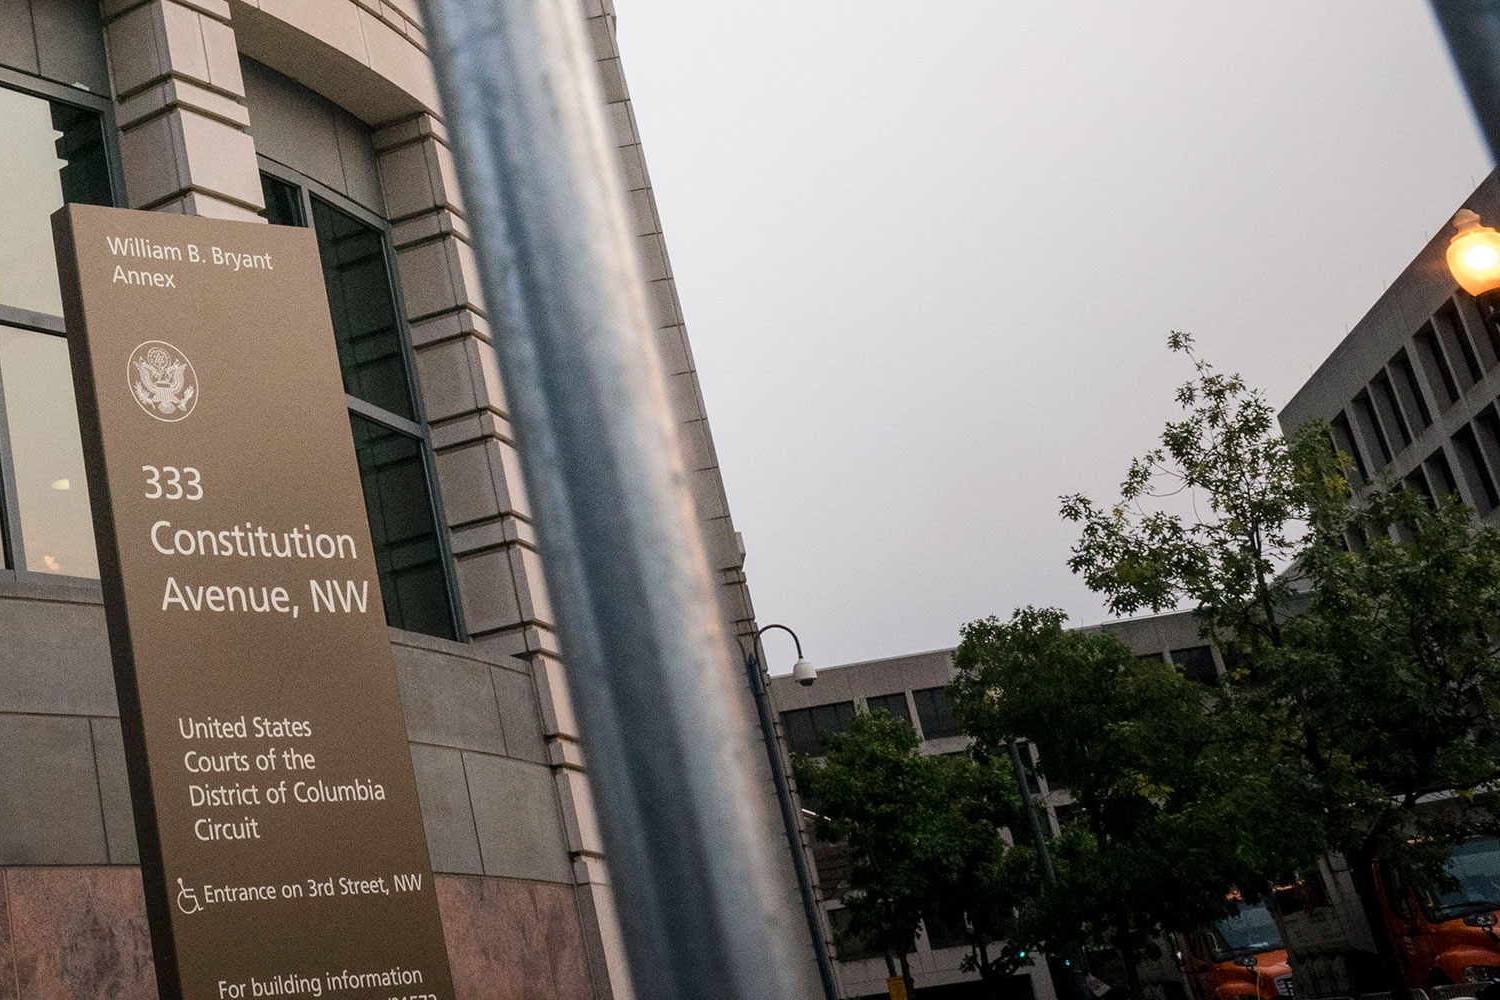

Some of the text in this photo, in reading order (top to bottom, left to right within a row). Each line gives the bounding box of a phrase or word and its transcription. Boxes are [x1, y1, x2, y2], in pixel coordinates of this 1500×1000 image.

[107, 236, 274, 271] William B. Bryant
[112, 265, 176, 288] Annex
[142, 465, 204, 500] 333
[151, 521, 357, 559] Constitution
[162, 577, 369, 618] Avenue, NW
[179, 716, 312, 739] United States
[184, 748, 316, 773] Courts of the
[189, 779, 386, 806] District of Columbia
[194, 817, 261, 841] Circuit
[204, 874, 422, 903] Entrance on 3rd Street, NW
[218, 966, 423, 999] For building information
